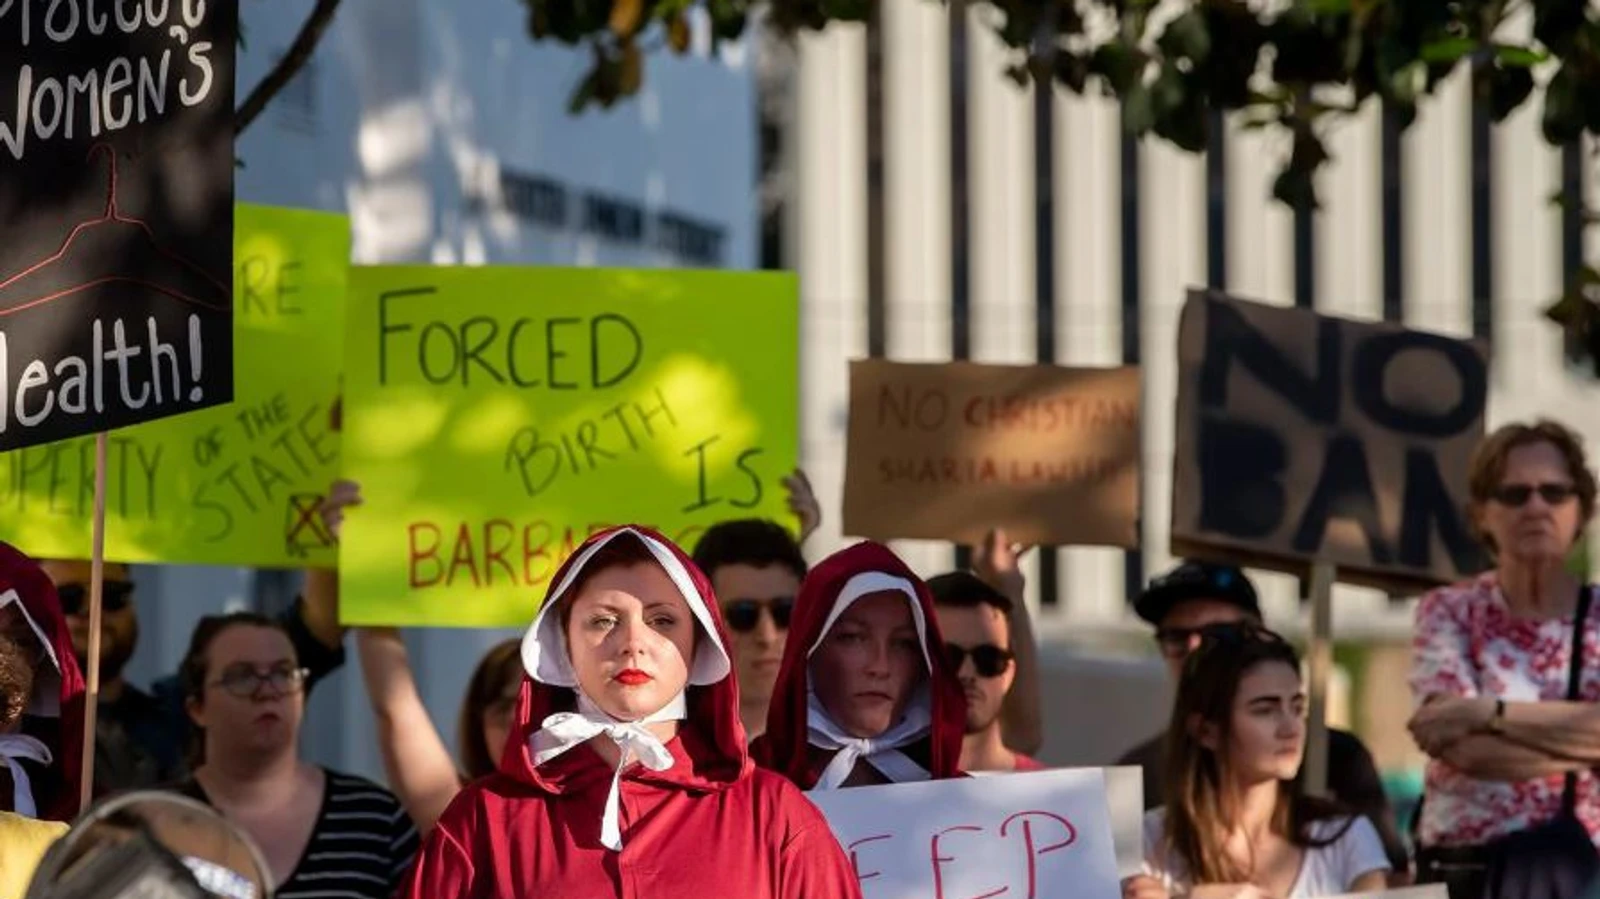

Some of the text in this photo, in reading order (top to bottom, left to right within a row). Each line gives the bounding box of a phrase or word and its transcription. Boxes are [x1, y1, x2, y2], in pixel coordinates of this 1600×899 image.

[0, 313, 204, 432] ealth!
[378, 286, 643, 390] FORCED
[1197, 299, 1488, 440] NO
[236, 391, 291, 440] THE
[504, 386, 678, 497] BIRTH
[877, 383, 1137, 433] NO CHRISTIAN
[192, 404, 339, 544] STATE
[680, 435, 765, 514] IS
[878, 456, 998, 484] SHARIA
[1196, 418, 1494, 577] BAN
